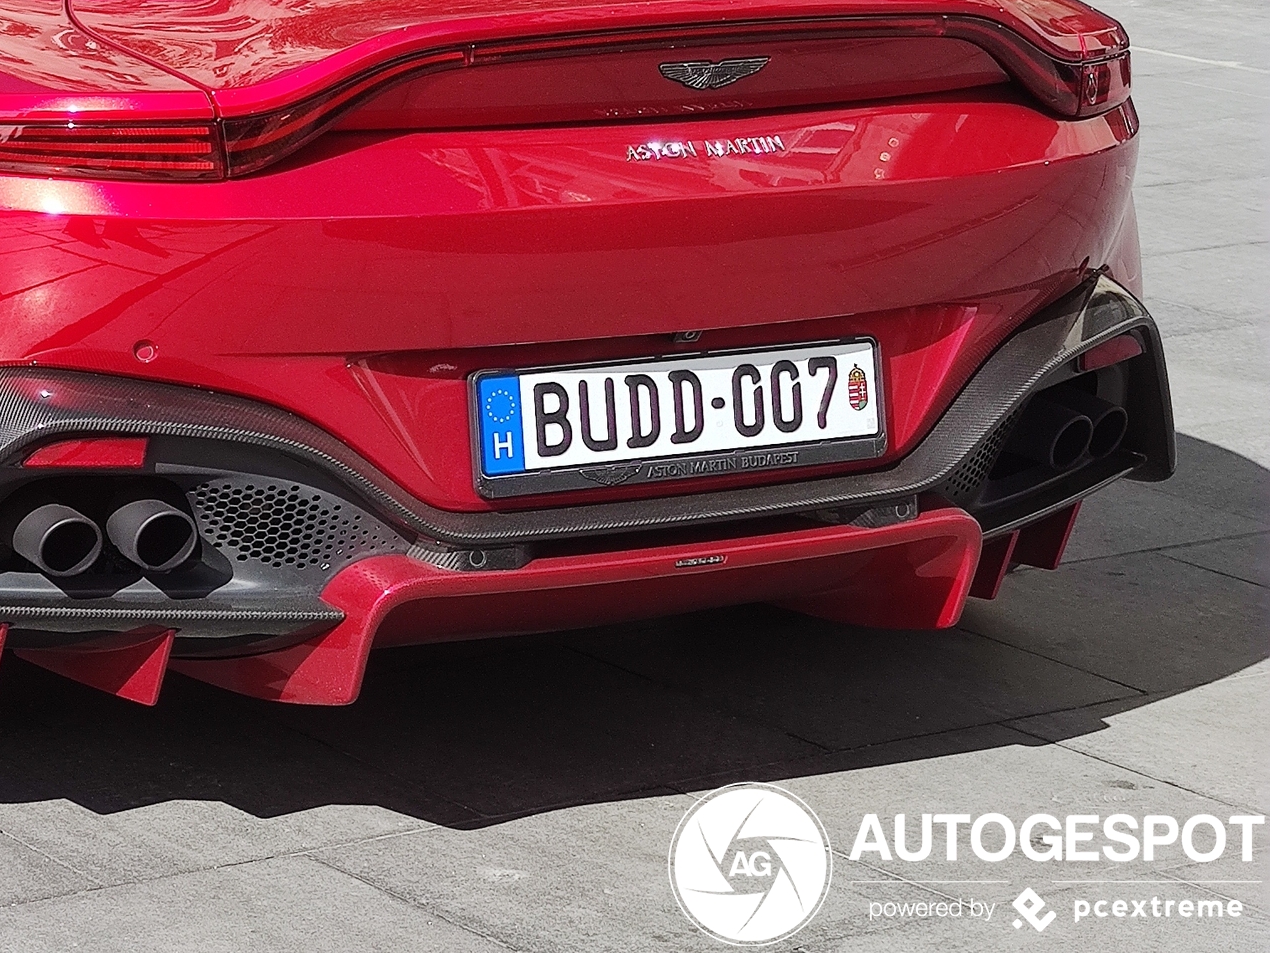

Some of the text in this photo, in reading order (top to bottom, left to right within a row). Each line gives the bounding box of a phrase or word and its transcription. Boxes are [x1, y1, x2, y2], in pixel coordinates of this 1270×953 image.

[626, 134, 786, 162] ASTON MARTIN
[492, 430, 514, 461] H
[646, 450, 800, 480] ASTON MARTIN BUDAPEST
